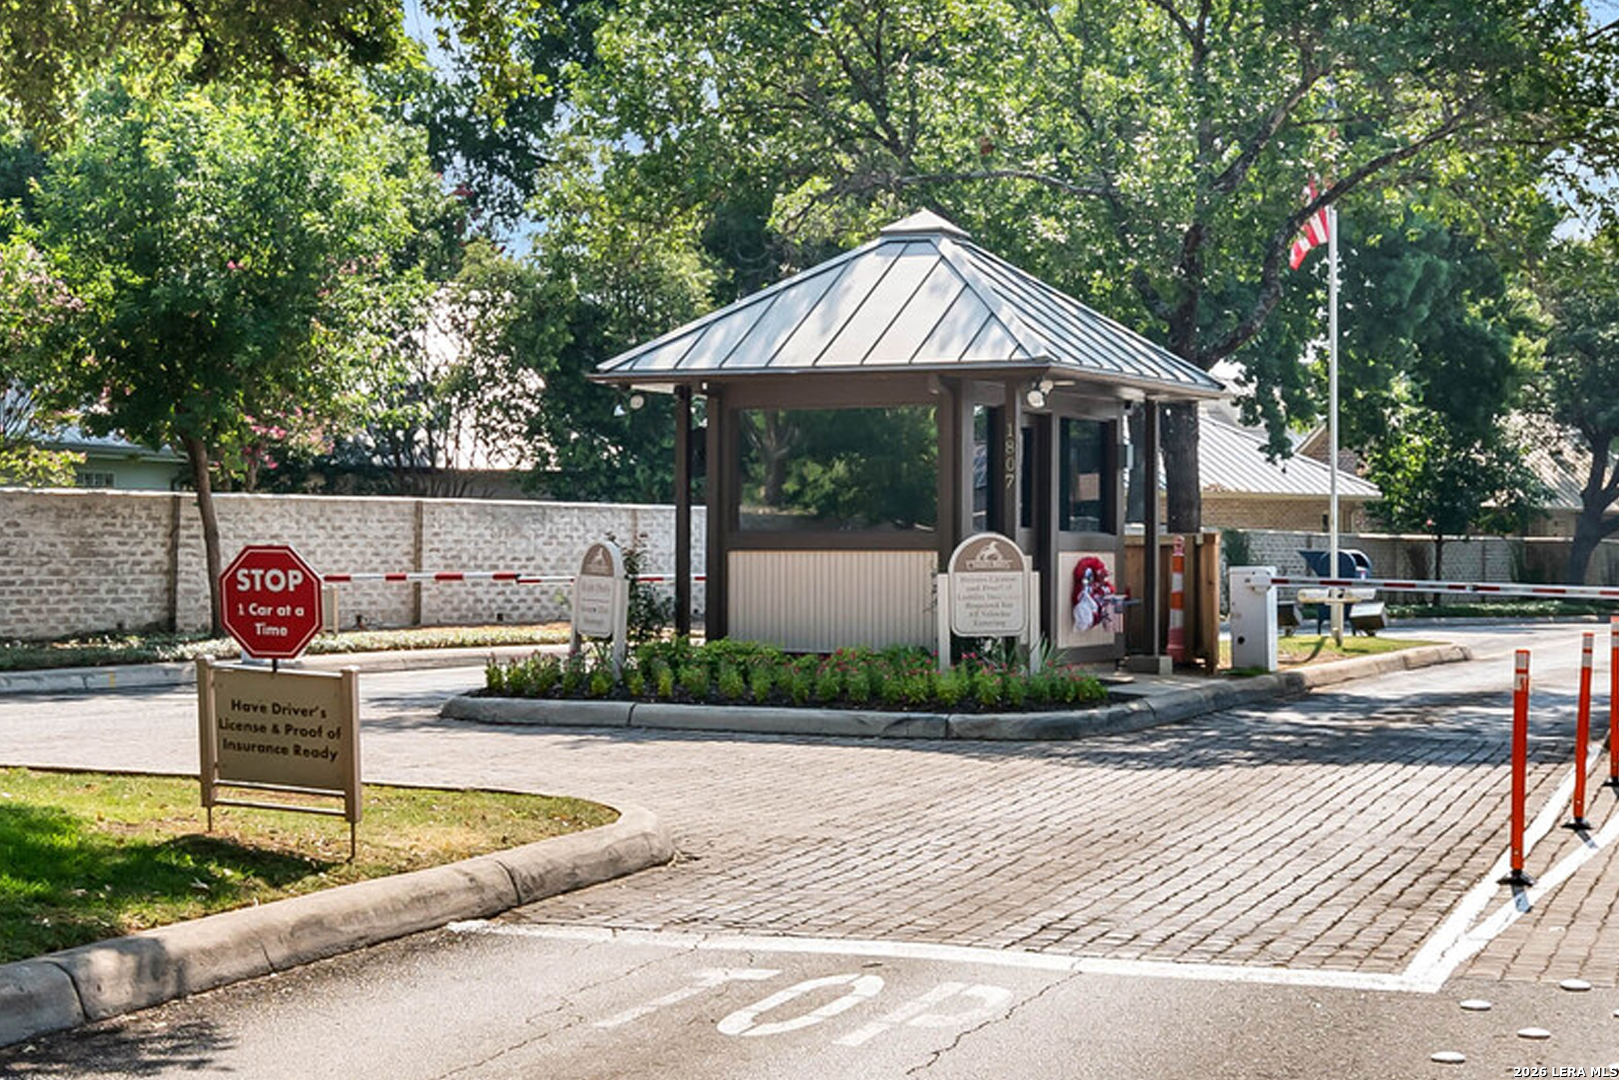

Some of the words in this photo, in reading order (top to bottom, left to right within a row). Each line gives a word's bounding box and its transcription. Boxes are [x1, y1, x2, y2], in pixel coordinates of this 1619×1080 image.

[1004, 423, 1015, 489] 1807
[236, 568, 304, 592] STOP
[237, 604, 245, 616] 1
[248, 603, 272, 617] Car
[276, 605, 292, 617] at
[294, 607, 304, 617] a
[255, 622, 288, 637] Time
[231, 699, 267, 715] Have
[271, 702, 327, 719] Driver's
[218, 717, 267, 734] License
[271, 724, 281, 735] &
[284, 725, 324, 739] Proof
[327, 727, 342, 740] of
[222, 738, 289, 756] Insurance
[293, 743, 338, 763] Ready
